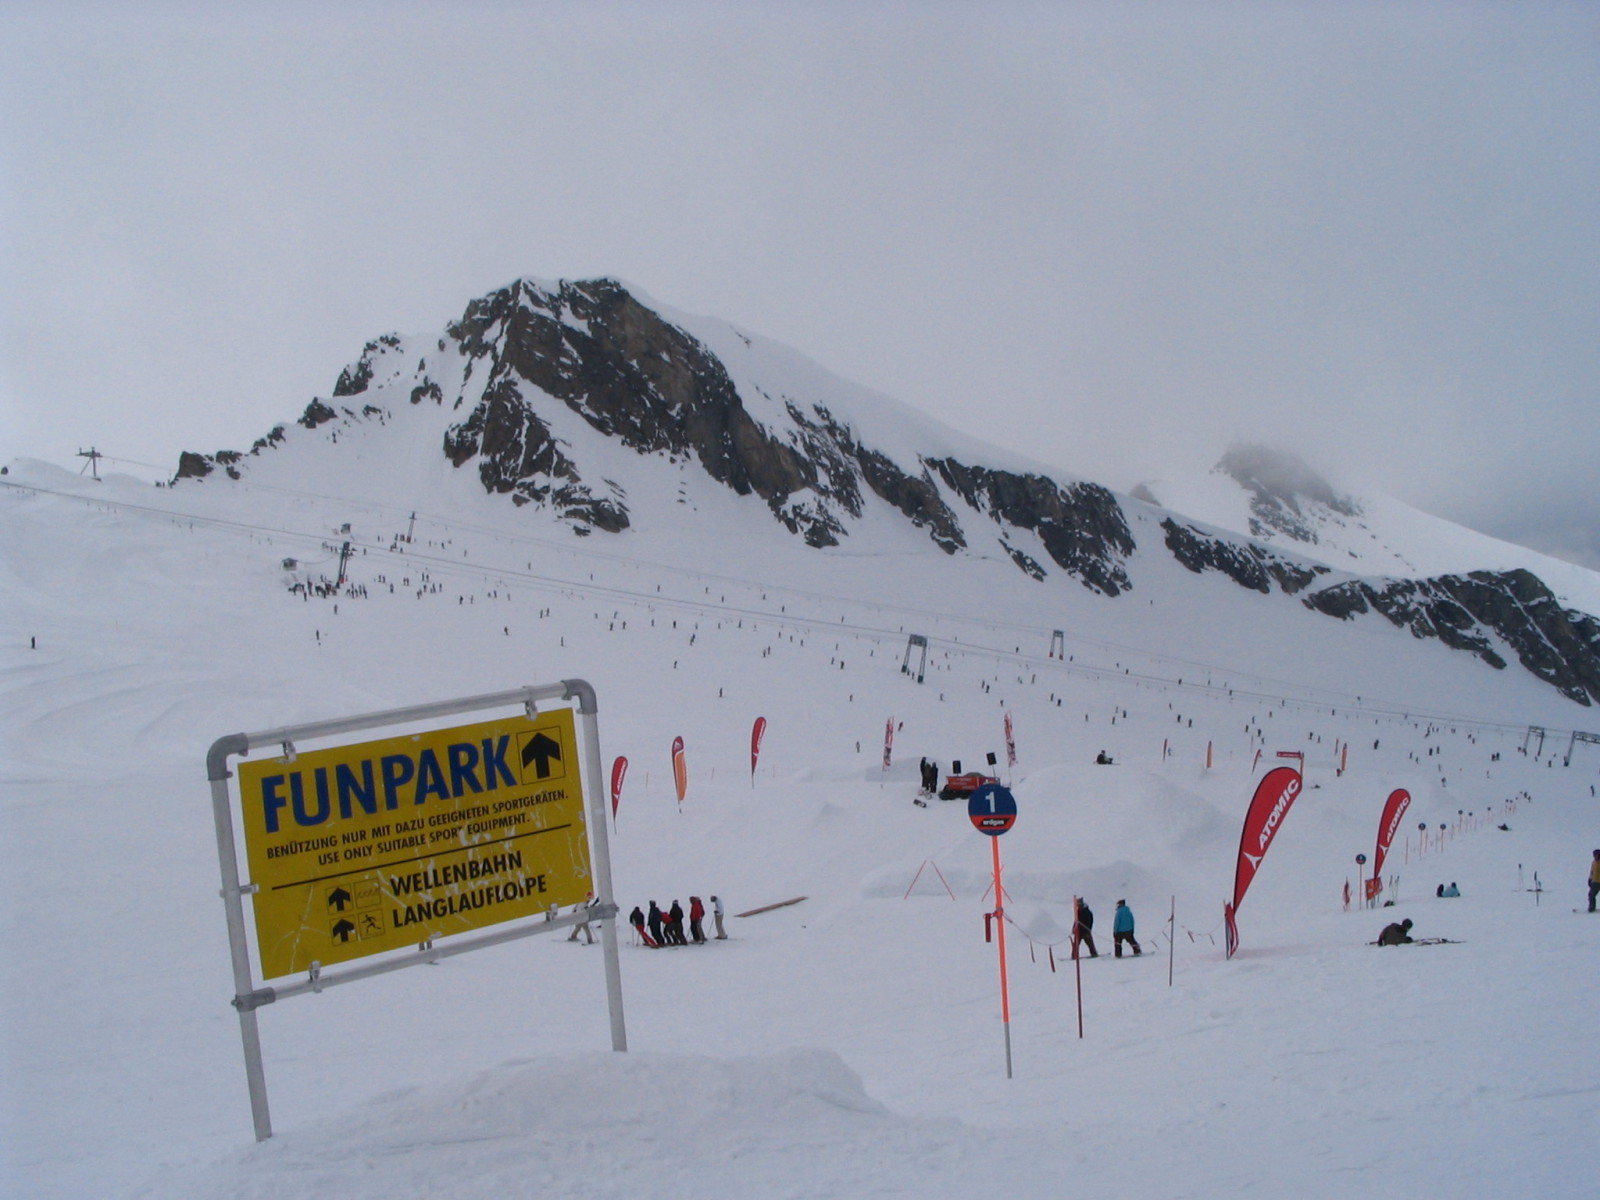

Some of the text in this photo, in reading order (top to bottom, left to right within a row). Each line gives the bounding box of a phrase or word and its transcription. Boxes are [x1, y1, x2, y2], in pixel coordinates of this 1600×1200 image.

[261, 734, 518, 833] FUNPARK
[985, 791, 995, 813] 1
[267, 789, 569, 859] BENÜTZUNG NUR MIT DAZU GEEIGNETEN SPORTGERÄTEN.
[318, 852, 340, 866] USE
[344, 845, 374, 861] ONLY
[378, 834, 426, 854] SUITABLE
[467, 814, 530, 836] EQUIPMENT.
[1258, 779, 1299, 850] ATOMIC
[1387, 797, 1409, 842] ATOMIC
[391, 850, 522, 897] WELLENBAHN
[392, 874, 548, 929] LANGLAUFLOIPE
